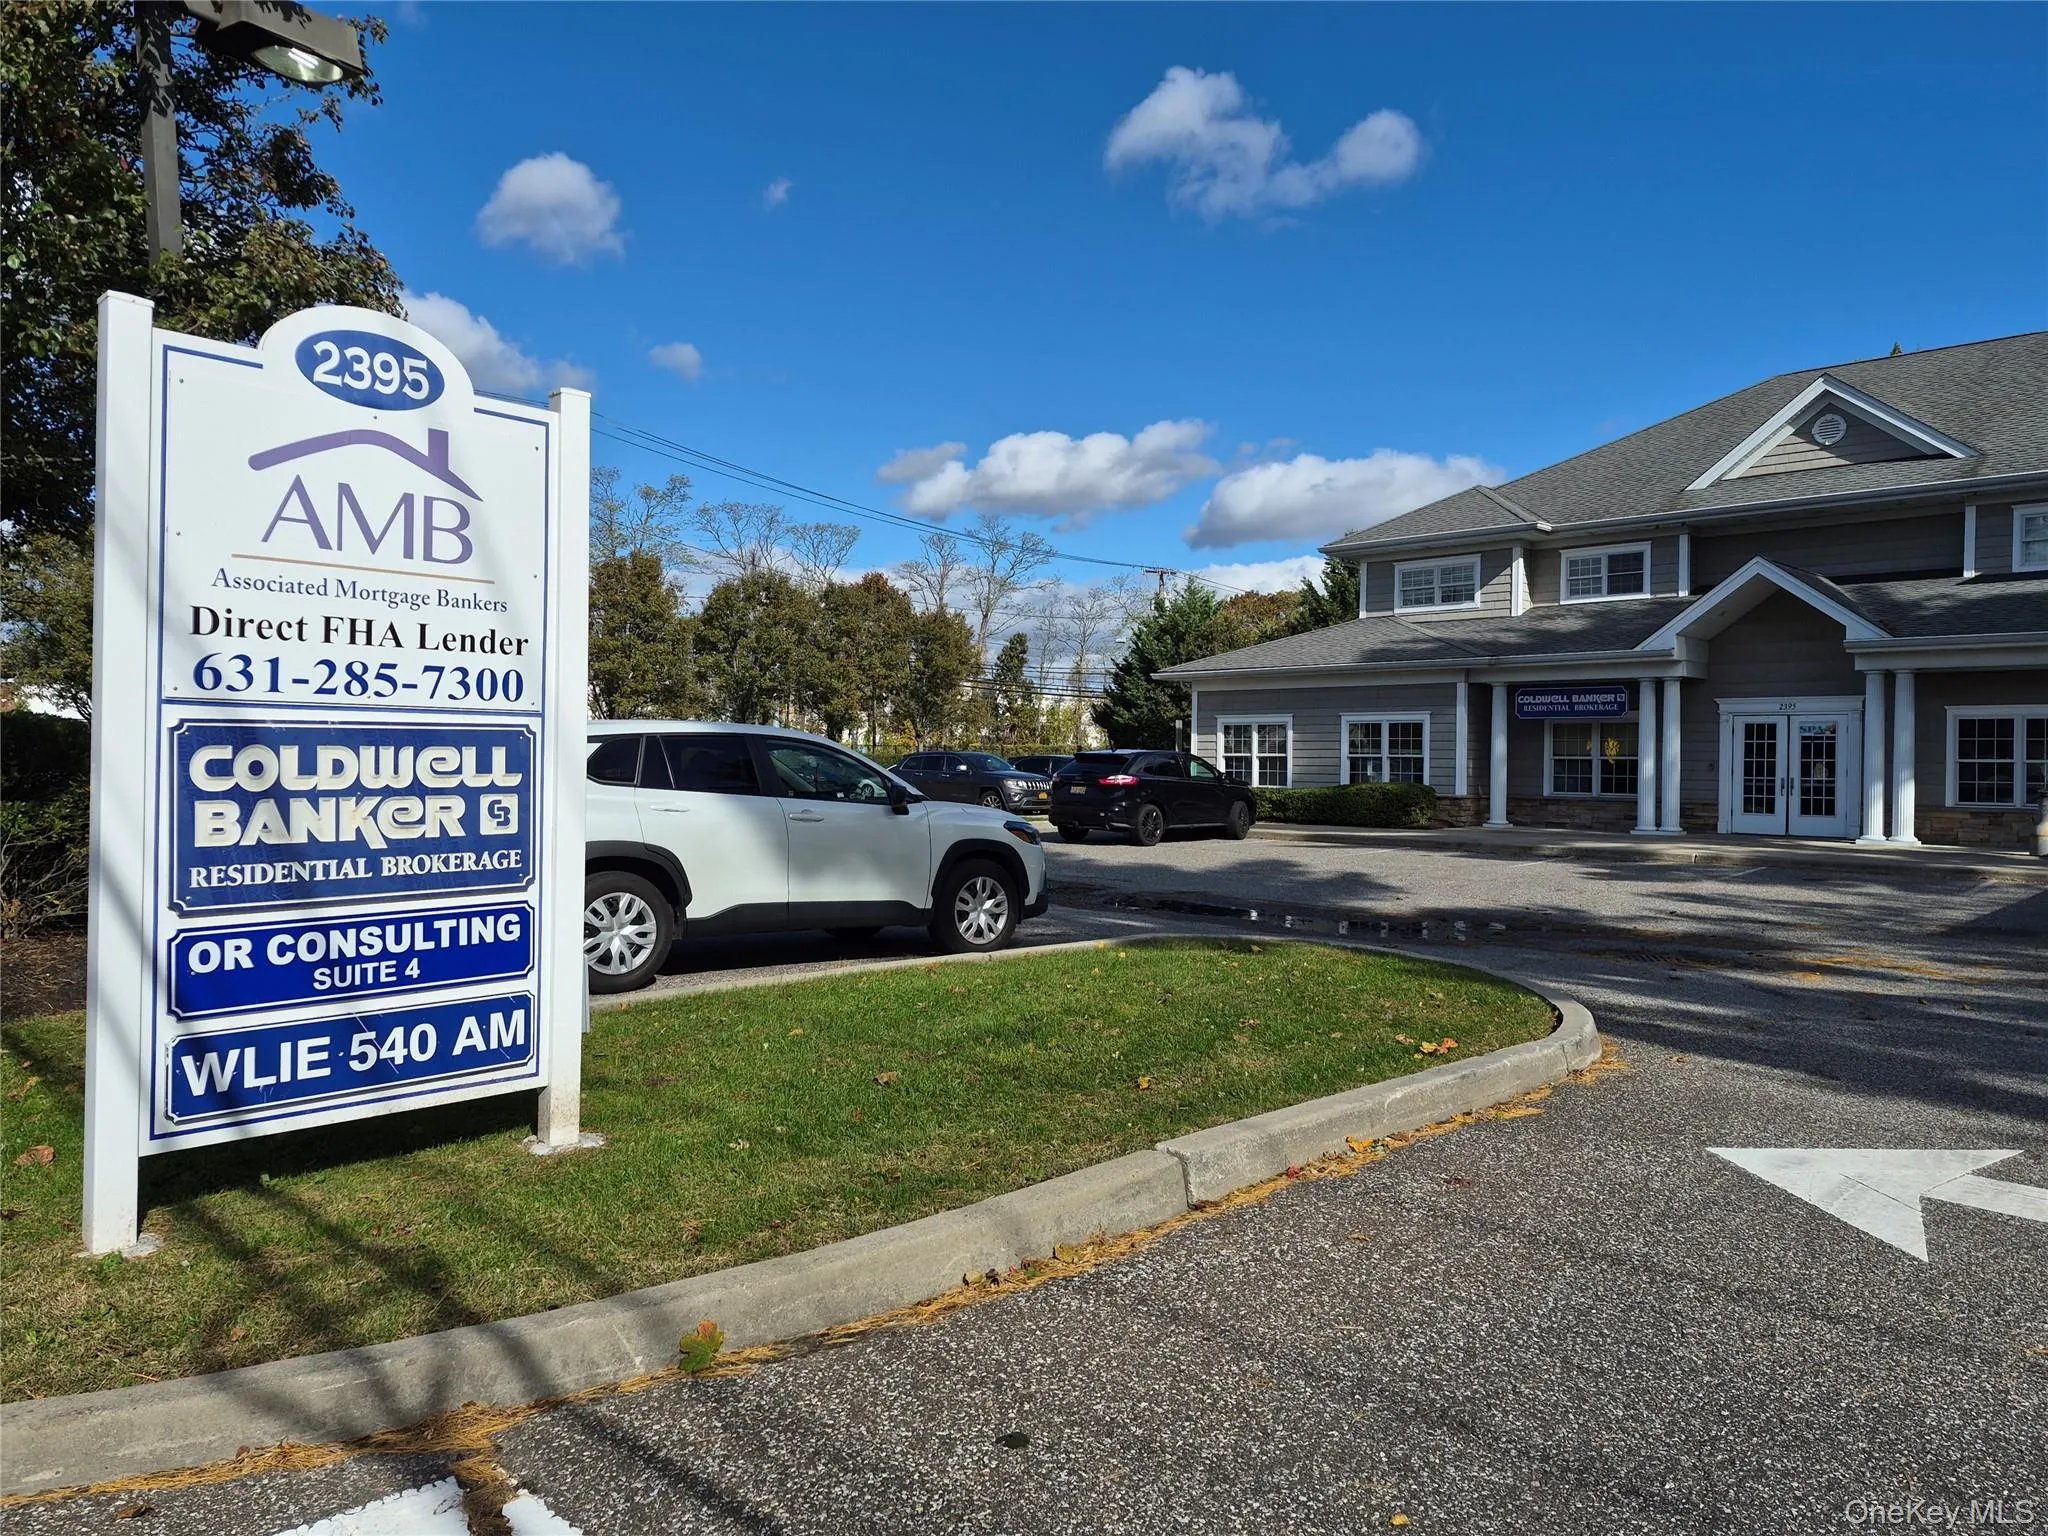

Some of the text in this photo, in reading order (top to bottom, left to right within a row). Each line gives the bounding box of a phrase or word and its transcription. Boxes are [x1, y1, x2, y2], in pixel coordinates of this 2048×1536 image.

[313, 340, 430, 400] 2395
[260, 474, 473, 565] AMB
[211, 568, 508, 613] Associated Mortgage Bankers
[188, 605, 530, 656] Direct FHA Lender
[192, 652, 525, 702] 631-285-7300
[1575, 703, 1618, 711] BROKERAGE
[188, 849, 522, 888] RESIDENTIAL BROKERAGE
[188, 913, 521, 974] OR CONSULTING
[312, 957, 421, 990] SUITE 4
[180, 1008, 525, 1097] WLIE 540 AM
